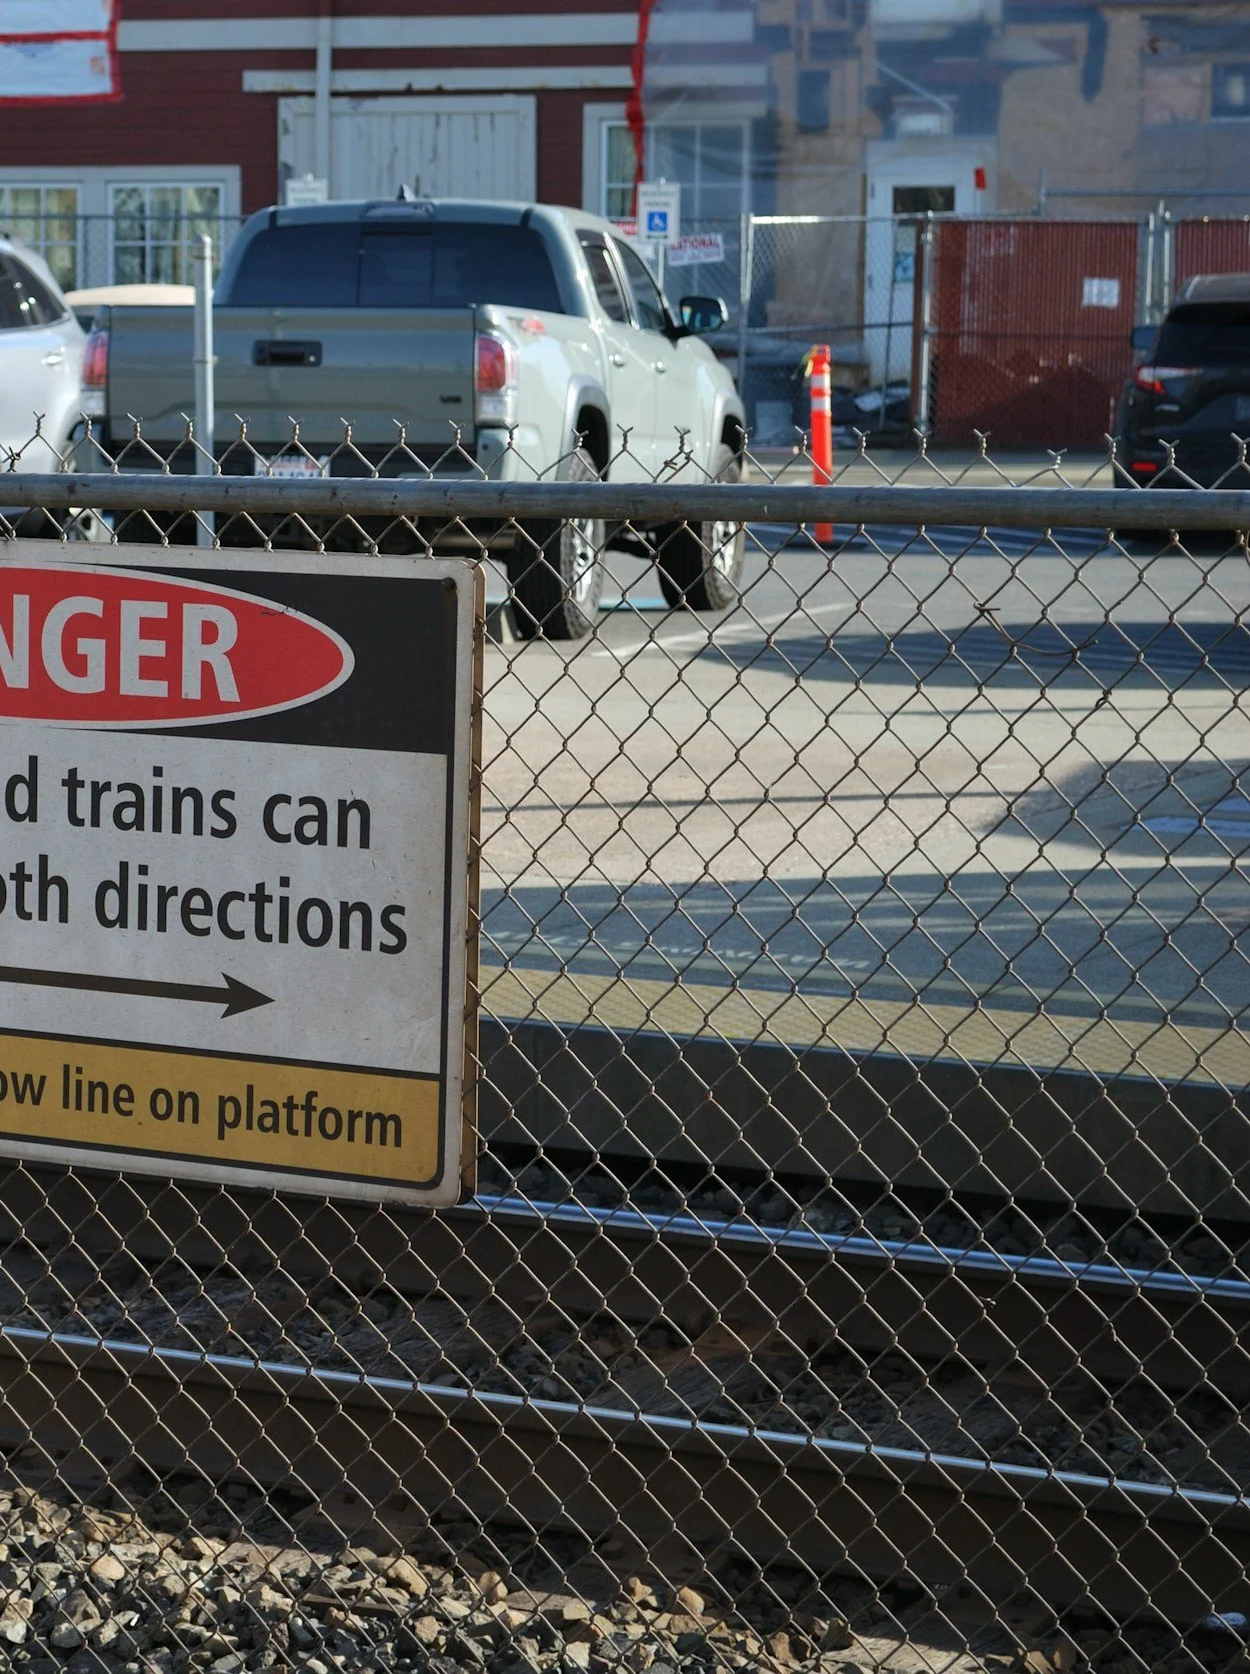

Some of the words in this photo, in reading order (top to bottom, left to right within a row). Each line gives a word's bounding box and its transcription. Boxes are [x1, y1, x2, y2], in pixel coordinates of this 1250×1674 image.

[62, 766, 237, 838] trains
[263, 794, 370, 849] can
[95, 861, 407, 954] directions
[63, 1064, 134, 1116] line
[150, 1088, 199, 1124] on
[218, 1084, 401, 1147] platform
